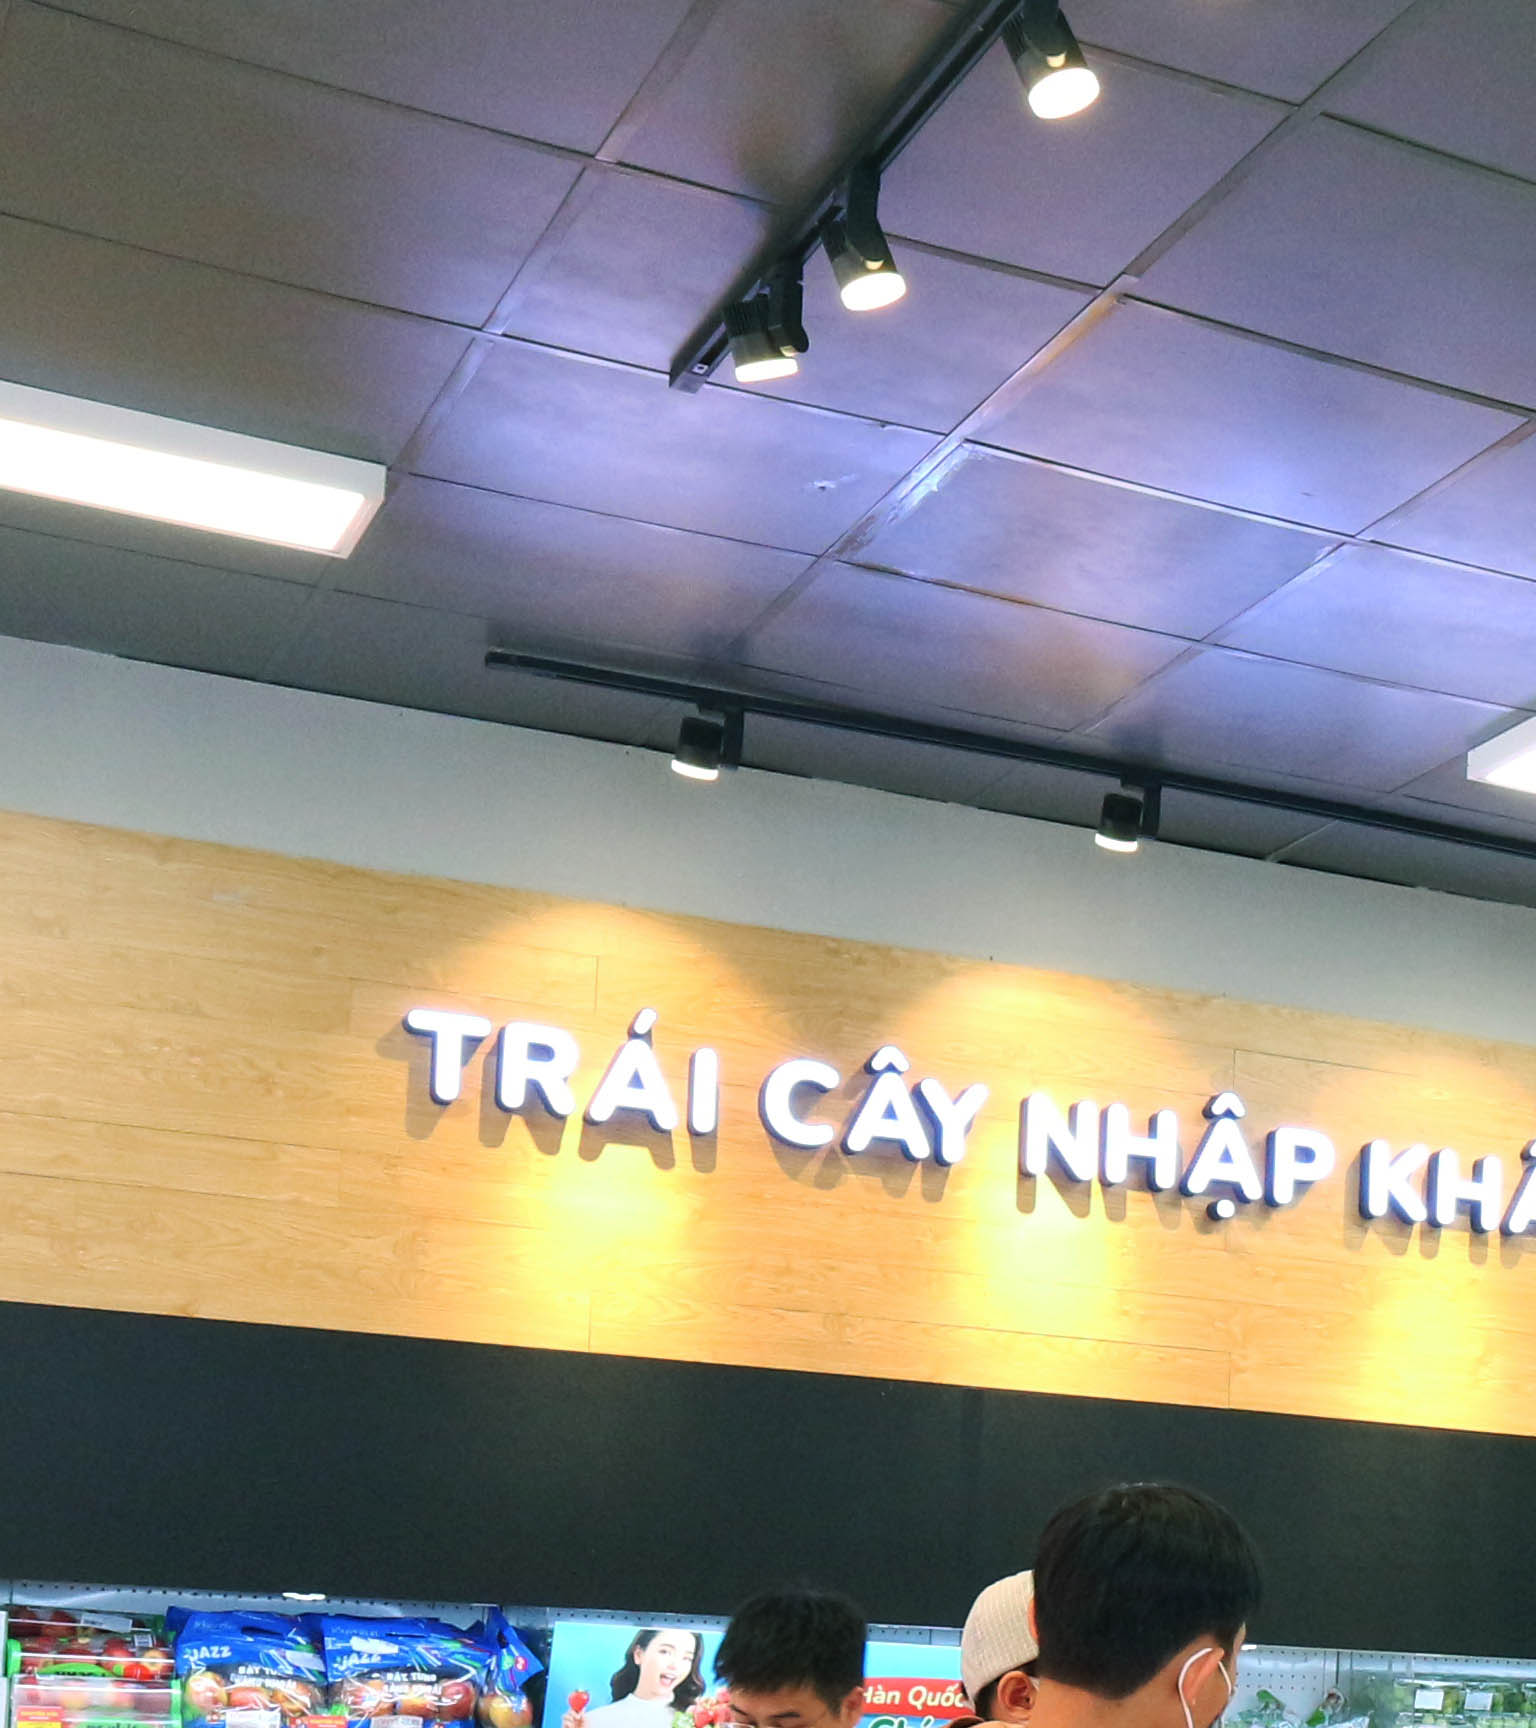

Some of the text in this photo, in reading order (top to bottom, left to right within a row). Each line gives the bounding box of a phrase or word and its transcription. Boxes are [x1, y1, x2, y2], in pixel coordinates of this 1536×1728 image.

[403, 1007, 717, 1135] TRÁI
[760, 1045, 989, 1166] CÂY
[1020, 1091, 1336, 1221] NHẬP
[908, 1683, 964, 1710] Quốc
